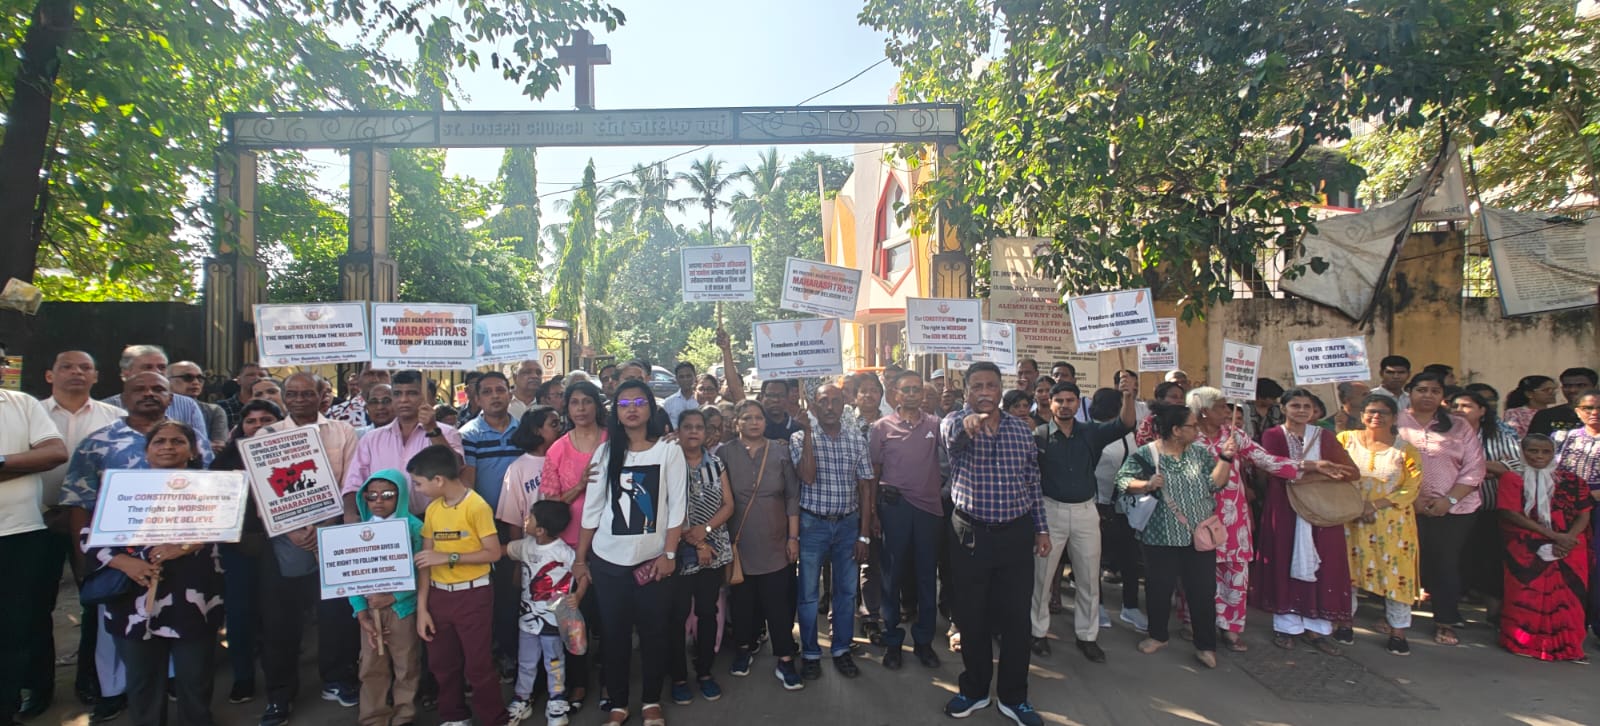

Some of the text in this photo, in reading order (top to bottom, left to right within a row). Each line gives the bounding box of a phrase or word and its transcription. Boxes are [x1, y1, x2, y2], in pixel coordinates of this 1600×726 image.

[470, 122, 520, 136] JOSEPH
[528, 122, 584, 136] CHURCH
[792, 276, 854, 294] MAHARASHTRA'S
[382, 326, 467, 336] MAHARASHTRA'S
[263, 432, 308, 446] CONSTITUTION
[251, 445, 278, 456] UPHOLDS
[292, 439, 307, 447] RIGHT
[263, 451, 282, 460] FREELY
[283, 445, 310, 455] WORSHIP
[292, 450, 312, 459] BELIEVE
[268, 485, 330, 507] WE PROTEST AGAINST
[270, 491, 332, 515] MAHARASHTRA'S
[345, 545, 380, 554] CONSTITUTION
